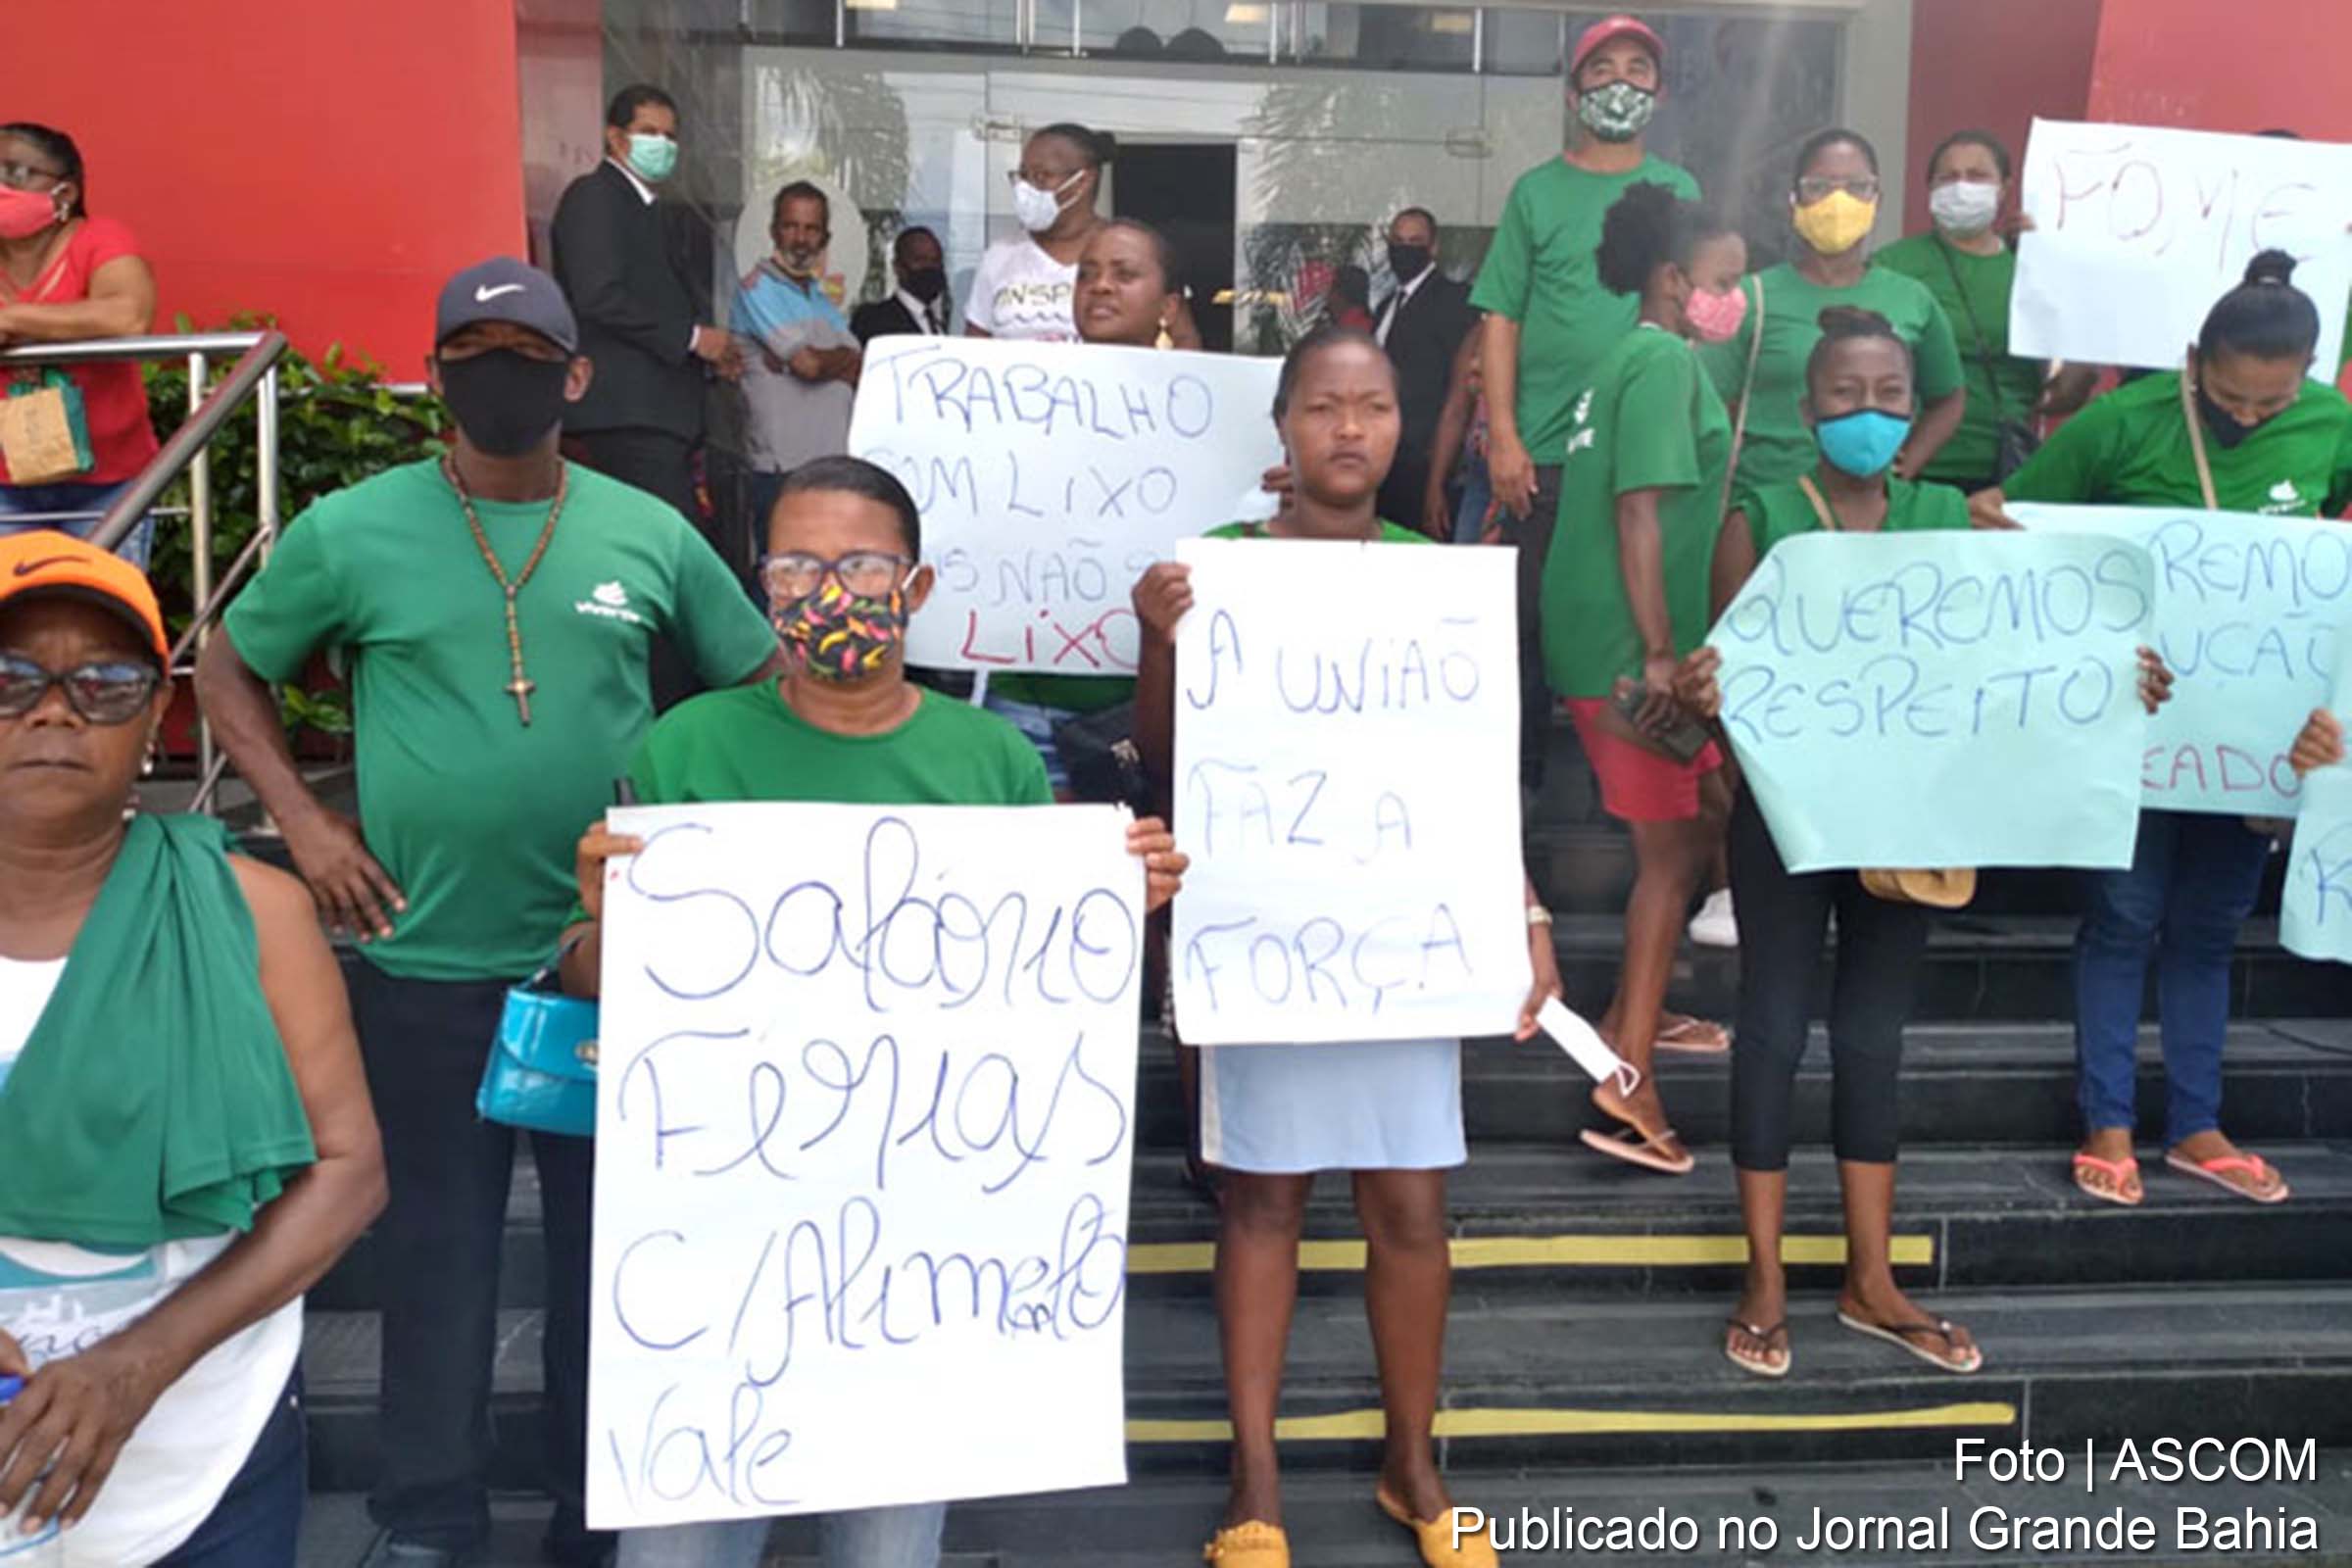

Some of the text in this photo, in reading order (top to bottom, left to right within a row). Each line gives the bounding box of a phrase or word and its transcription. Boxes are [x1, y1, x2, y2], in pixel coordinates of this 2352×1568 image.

[868, 344, 1213, 438] TRABALHO
[1007, 449, 1177, 518] LIXO
[1726, 549, 2148, 658] QUEREMOS
[1187, 608, 1243, 710] A
[1721, 653, 2113, 744] RESPEITO
[1187, 757, 1412, 865] FAZ A
[1185, 902, 1474, 1015] FORÇA
[609, 1382, 802, 1517] Vale
